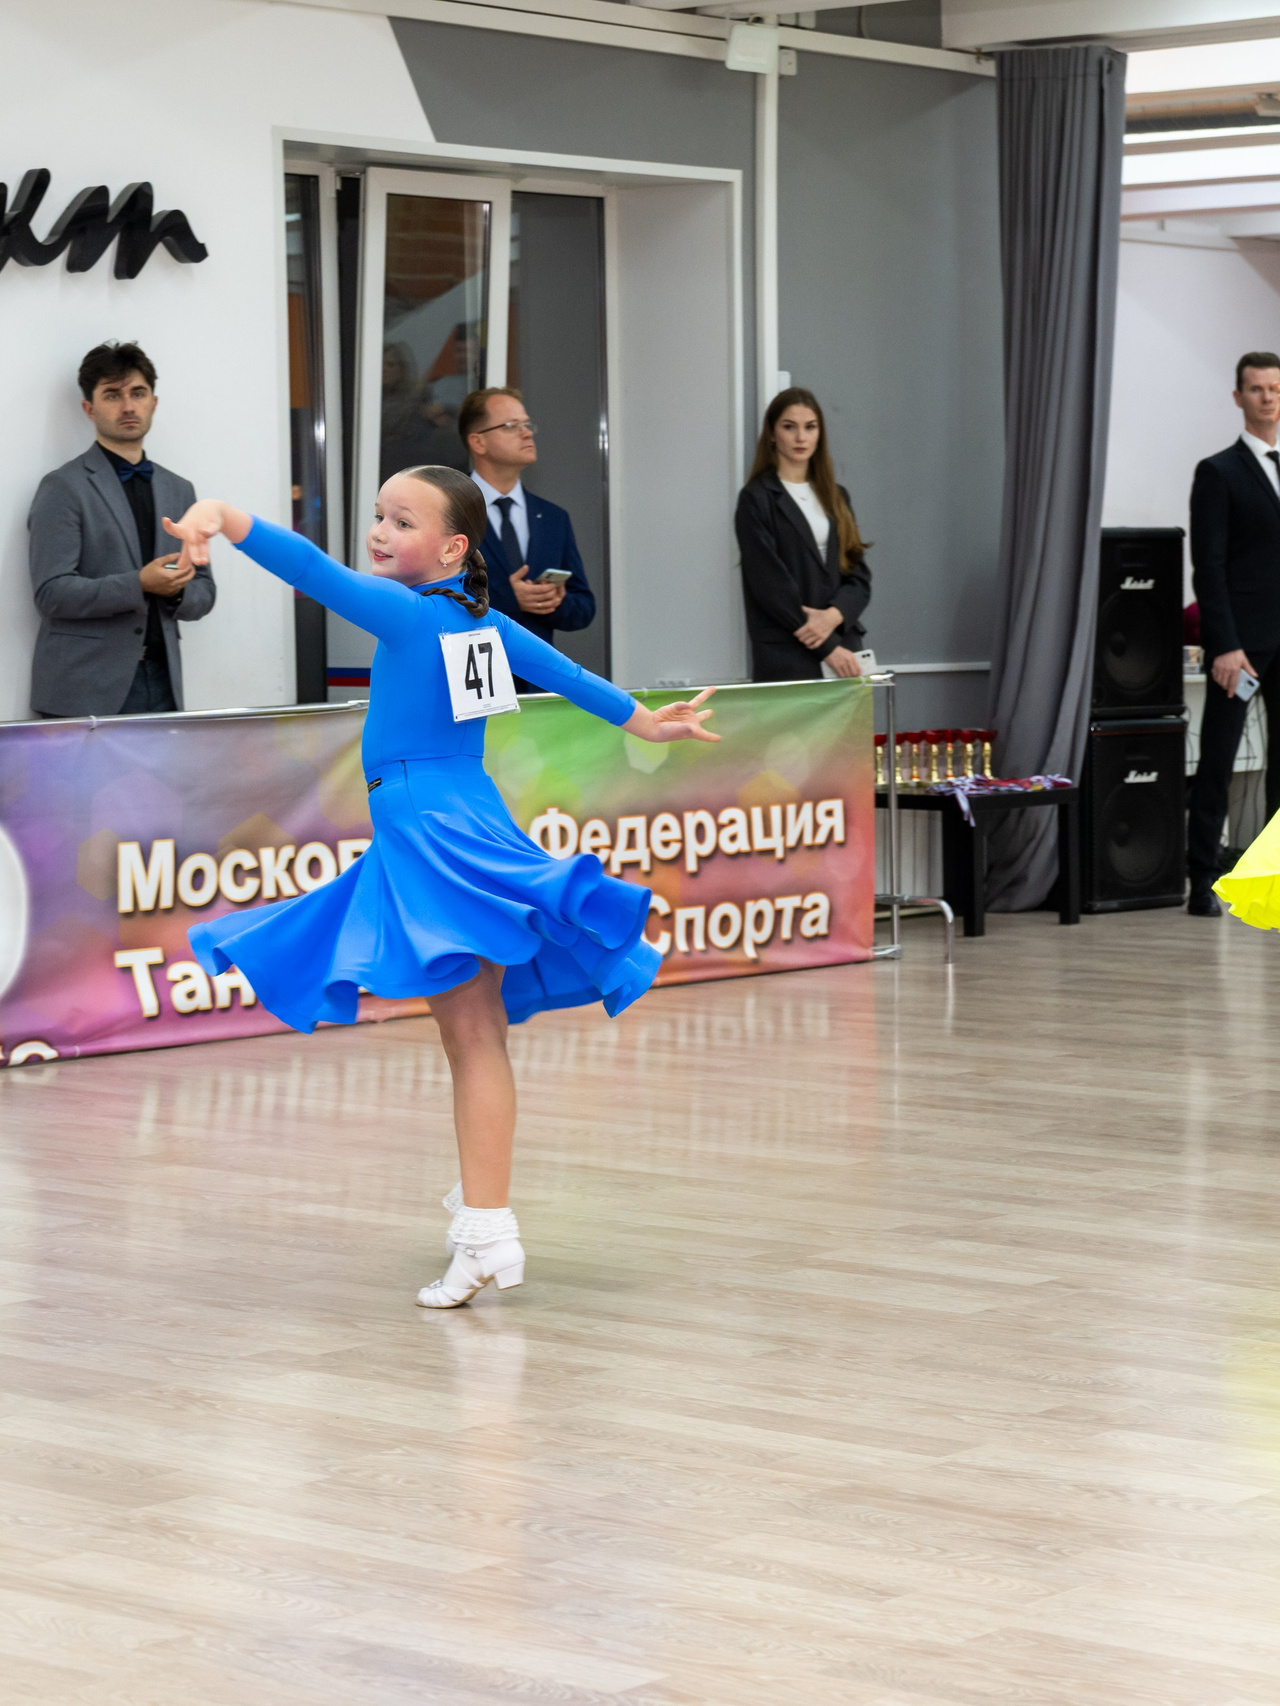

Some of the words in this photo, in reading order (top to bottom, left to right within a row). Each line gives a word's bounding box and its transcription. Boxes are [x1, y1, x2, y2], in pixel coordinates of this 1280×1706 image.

[465, 642, 494, 700] 47
[528, 799, 845, 875] Федерация
[641, 891, 831, 958] Спорта
